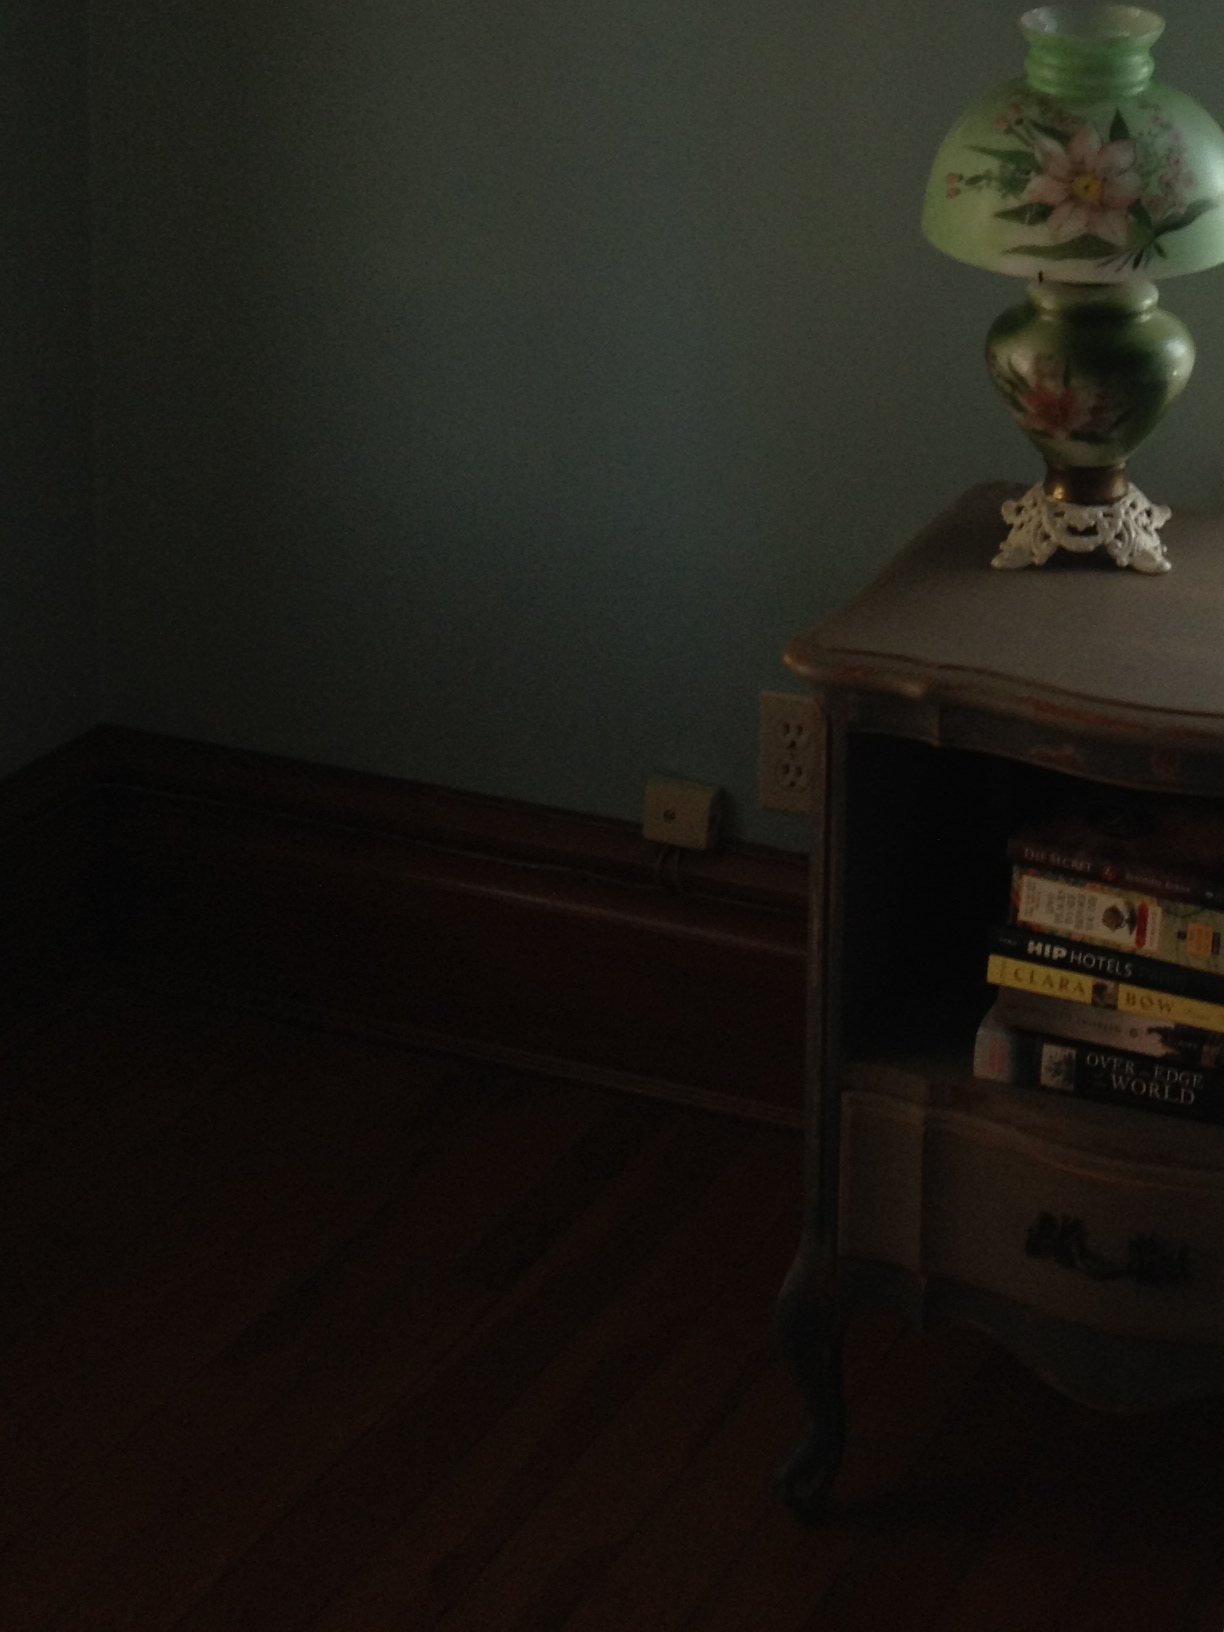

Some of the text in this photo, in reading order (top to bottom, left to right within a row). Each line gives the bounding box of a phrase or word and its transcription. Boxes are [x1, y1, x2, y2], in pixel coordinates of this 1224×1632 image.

[1026, 939, 1068, 961] HIP
[1069, 946, 1133, 979] HOTELS
[1013, 967, 1176, 1014] CLARA BOW
[1086, 1051, 1205, 1089] OVER EDGE
[1110, 1072, 1196, 1106] WORLD
